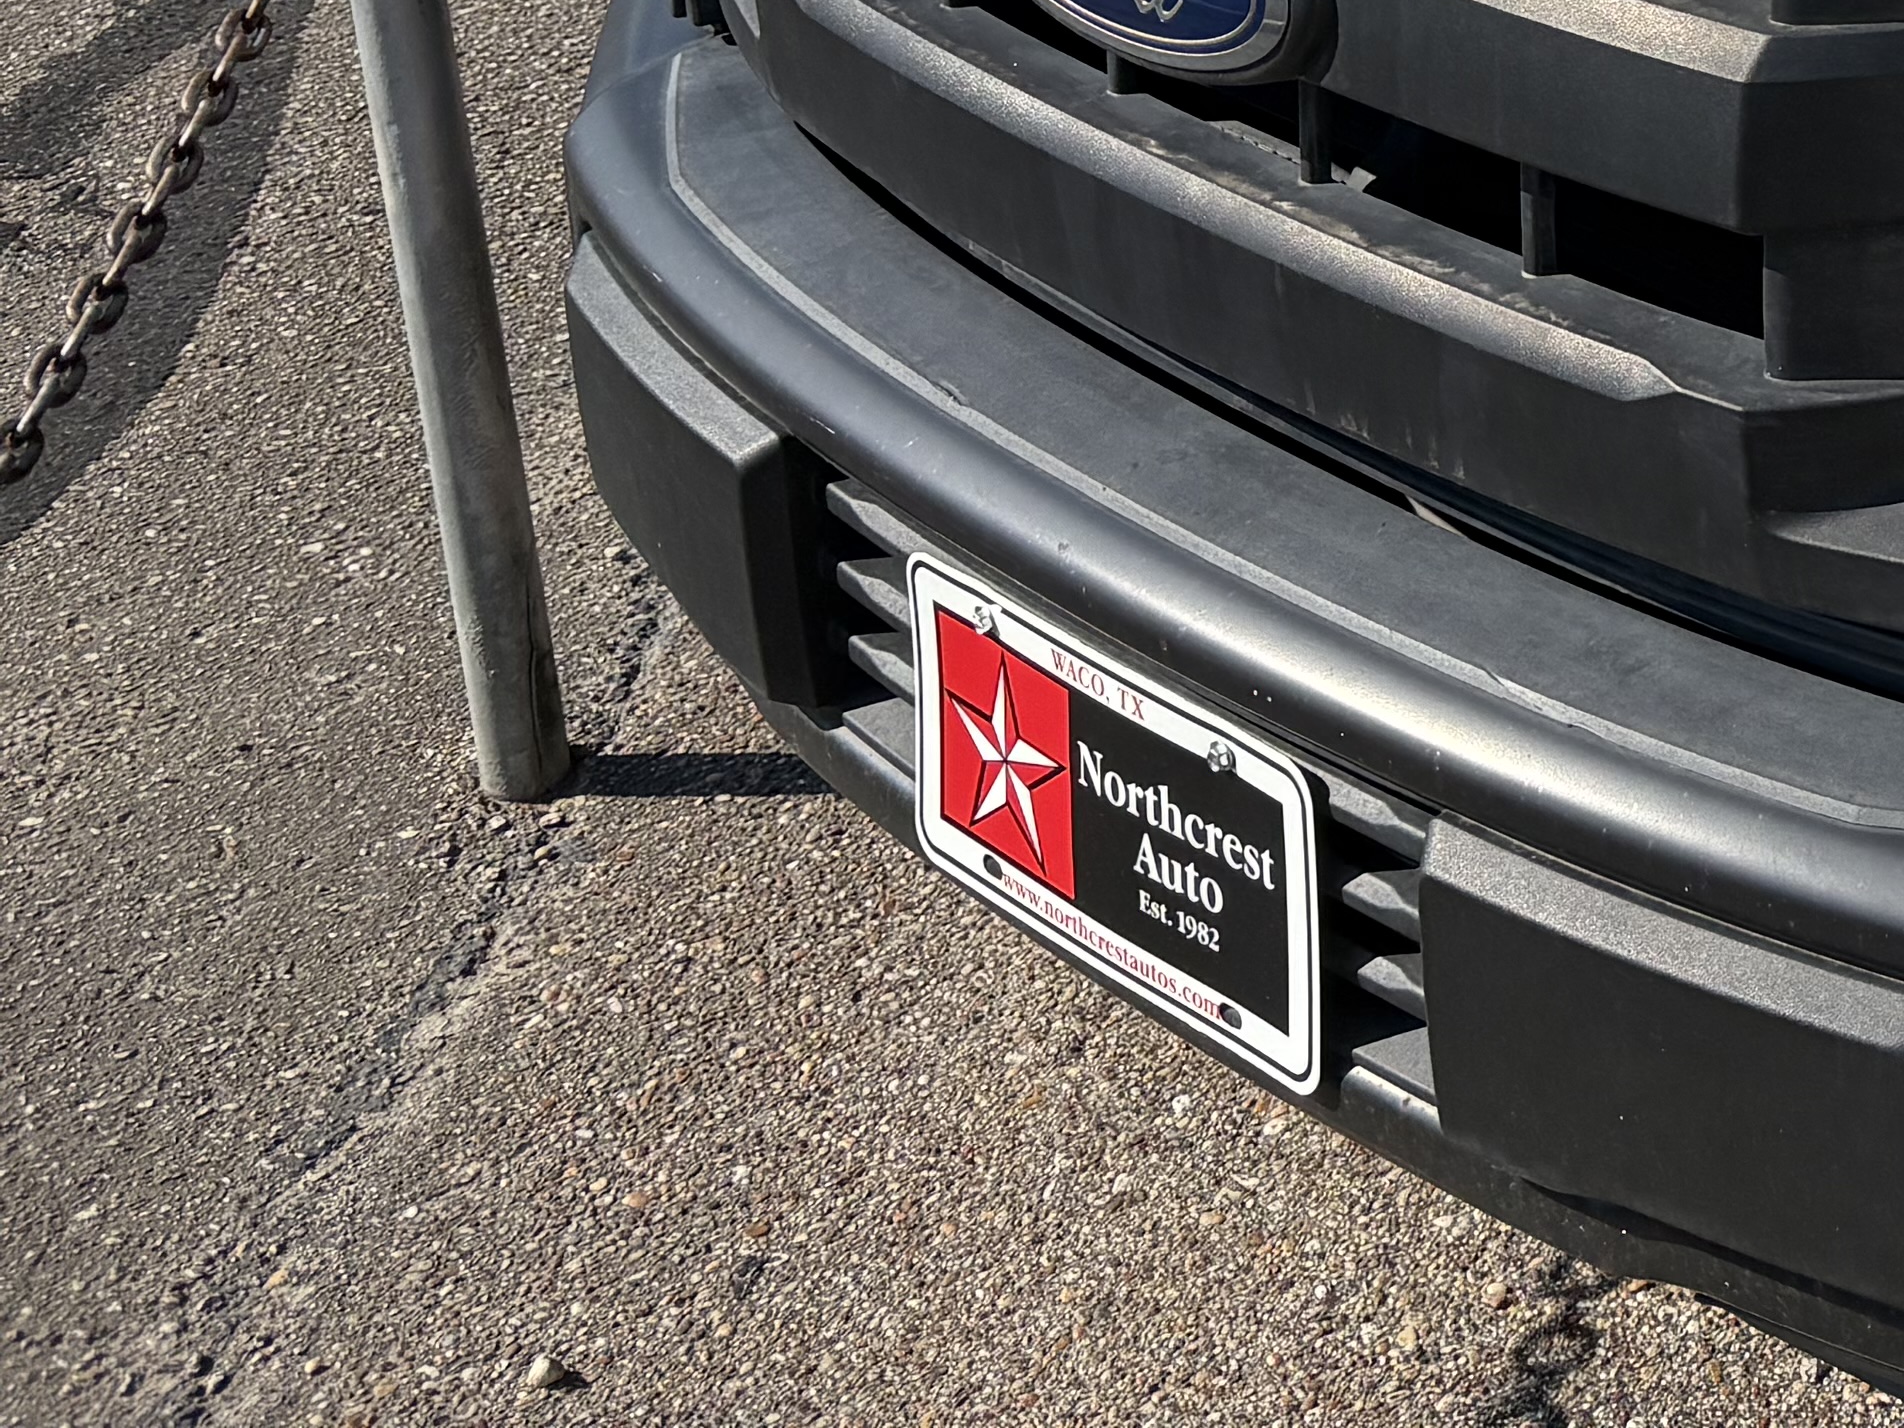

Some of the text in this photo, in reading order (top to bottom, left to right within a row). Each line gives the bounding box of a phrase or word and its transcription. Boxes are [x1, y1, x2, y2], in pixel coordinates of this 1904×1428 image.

[1049, 647, 1147, 721] WACO, TX
[1077, 739, 1277, 891] Northcrest
[1132, 831, 1226, 915] Auto
[1001, 871, 1222, 1021] www.northcrestautos.com
[1139, 890, 1221, 953] Est. 1982
